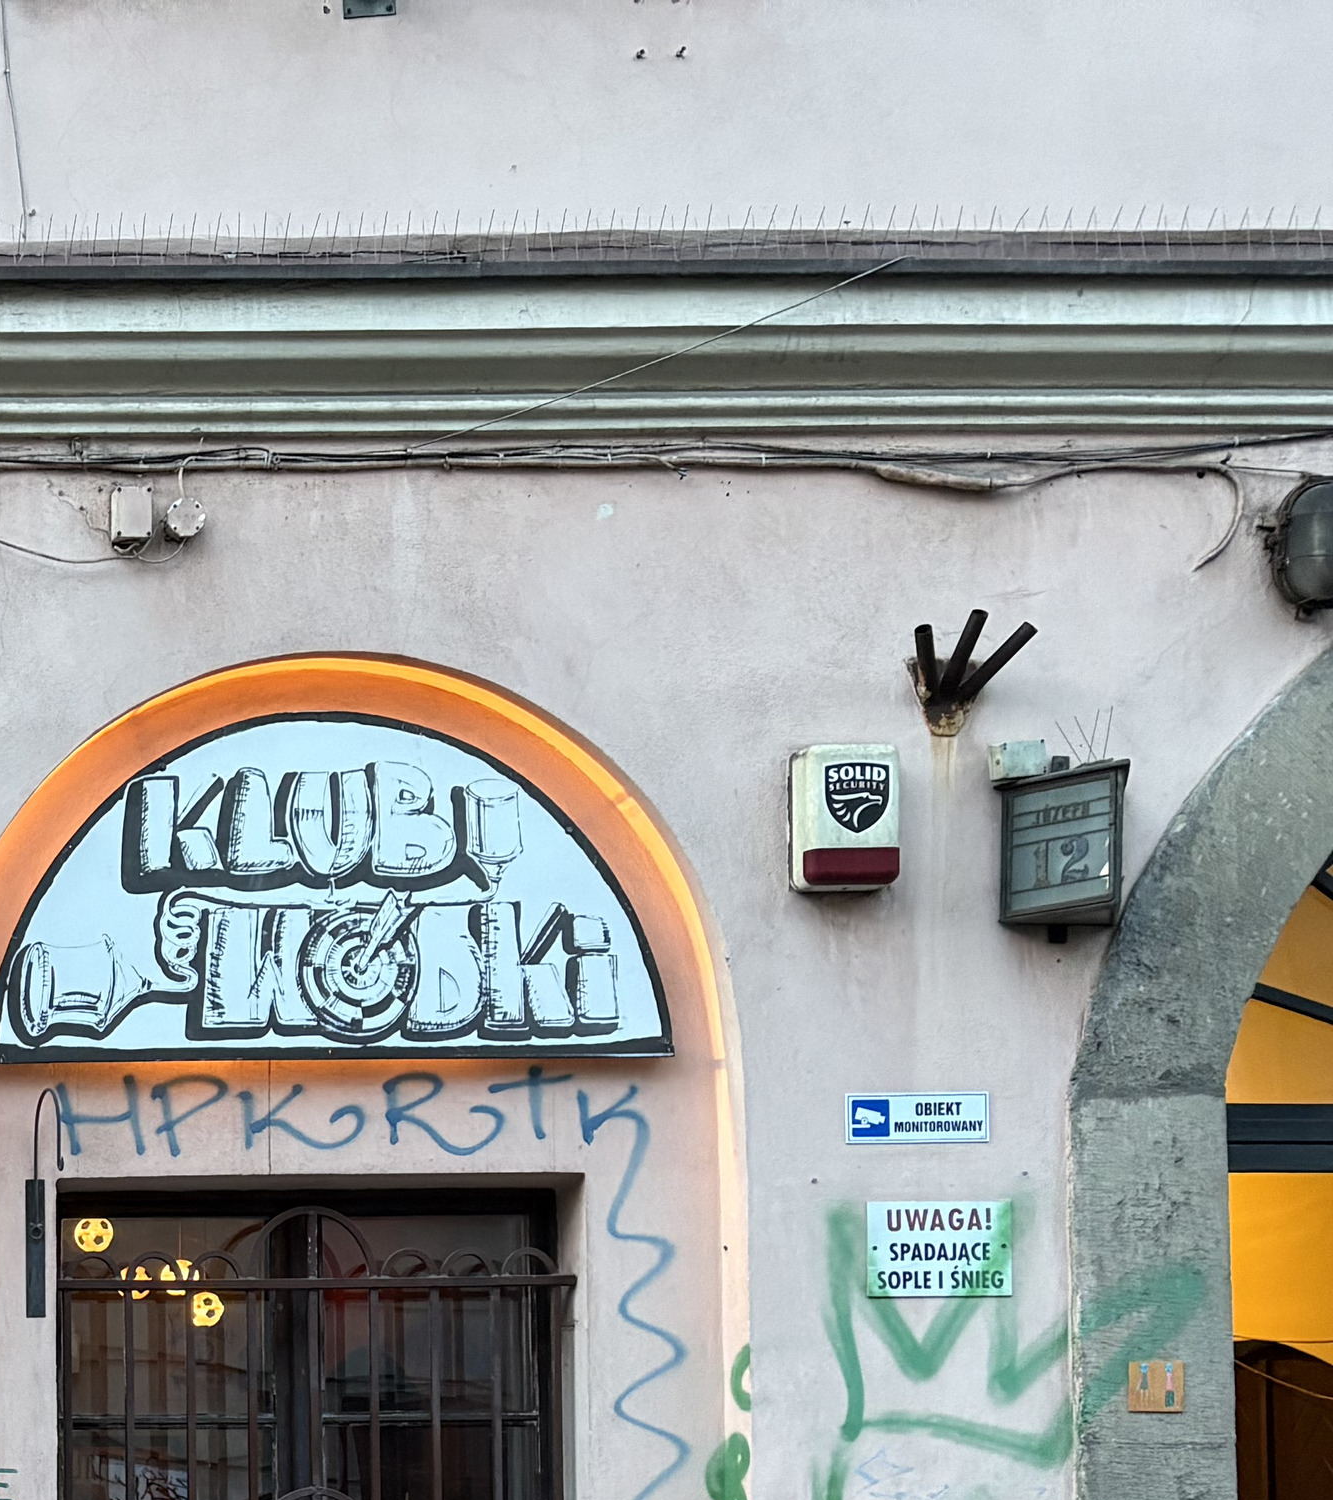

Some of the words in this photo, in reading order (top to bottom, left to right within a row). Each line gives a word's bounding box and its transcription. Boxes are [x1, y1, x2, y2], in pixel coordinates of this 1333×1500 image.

[828, 766, 886, 782] SOLID
[829, 781, 885, 791] SECURITY
[122, 761, 457, 892] KLUB
[915, 1102, 962, 1116] OBIEKT
[894, 1120, 983, 1133] MONITOROWANY
[887, 1208, 992, 1232] UWAGA!
[889, 1242, 991, 1266] SPADAJĄCE
[878, 1270, 932, 1290] SOPLE
[938, 1270, 943, 1289] I
[951, 1265, 1004, 1290] ŚNIEG
